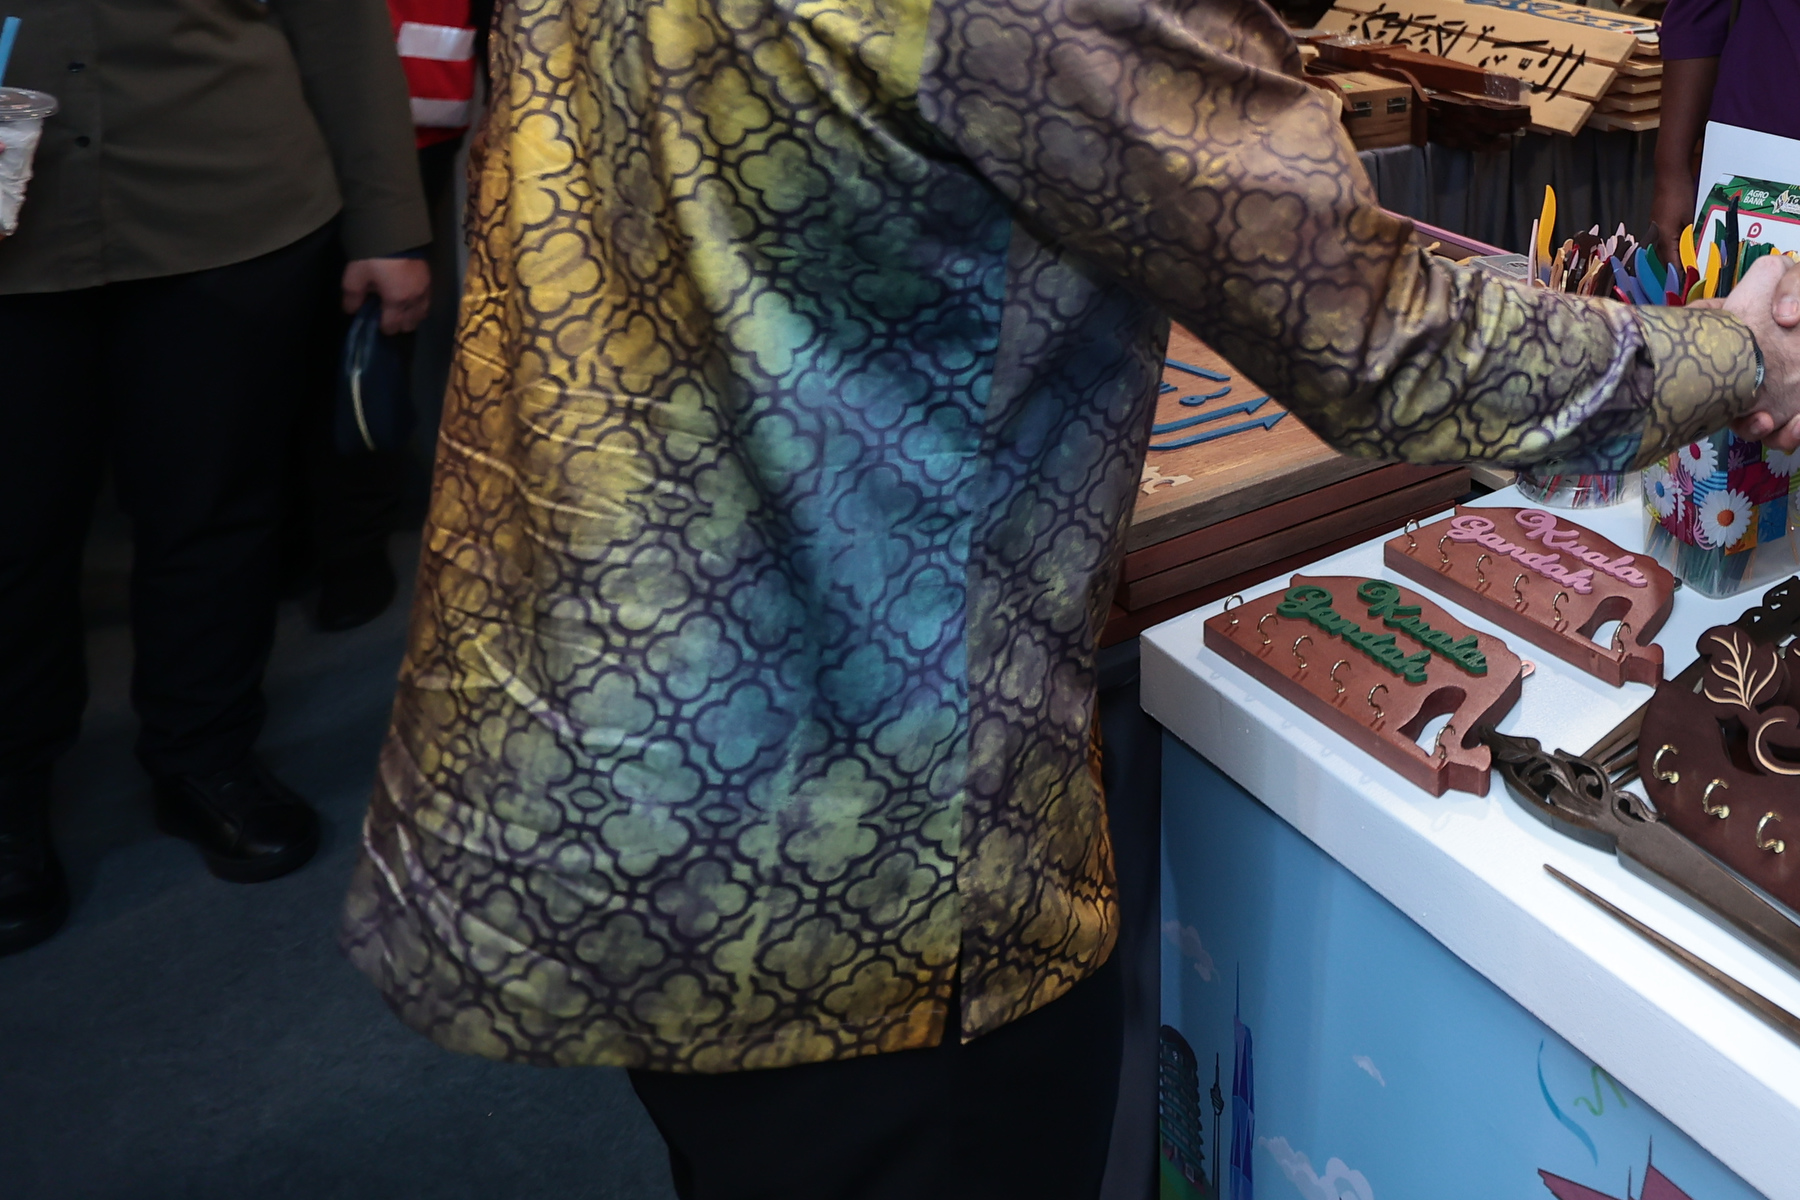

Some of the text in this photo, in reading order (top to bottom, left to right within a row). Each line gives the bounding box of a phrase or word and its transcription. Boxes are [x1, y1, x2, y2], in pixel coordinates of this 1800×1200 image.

[1743, 196, 1766, 207] BANK
[1747, 189, 1770, 199] AGRO
[1515, 509, 1648, 588] Kuala
[1357, 580, 1488, 675] Kuala
